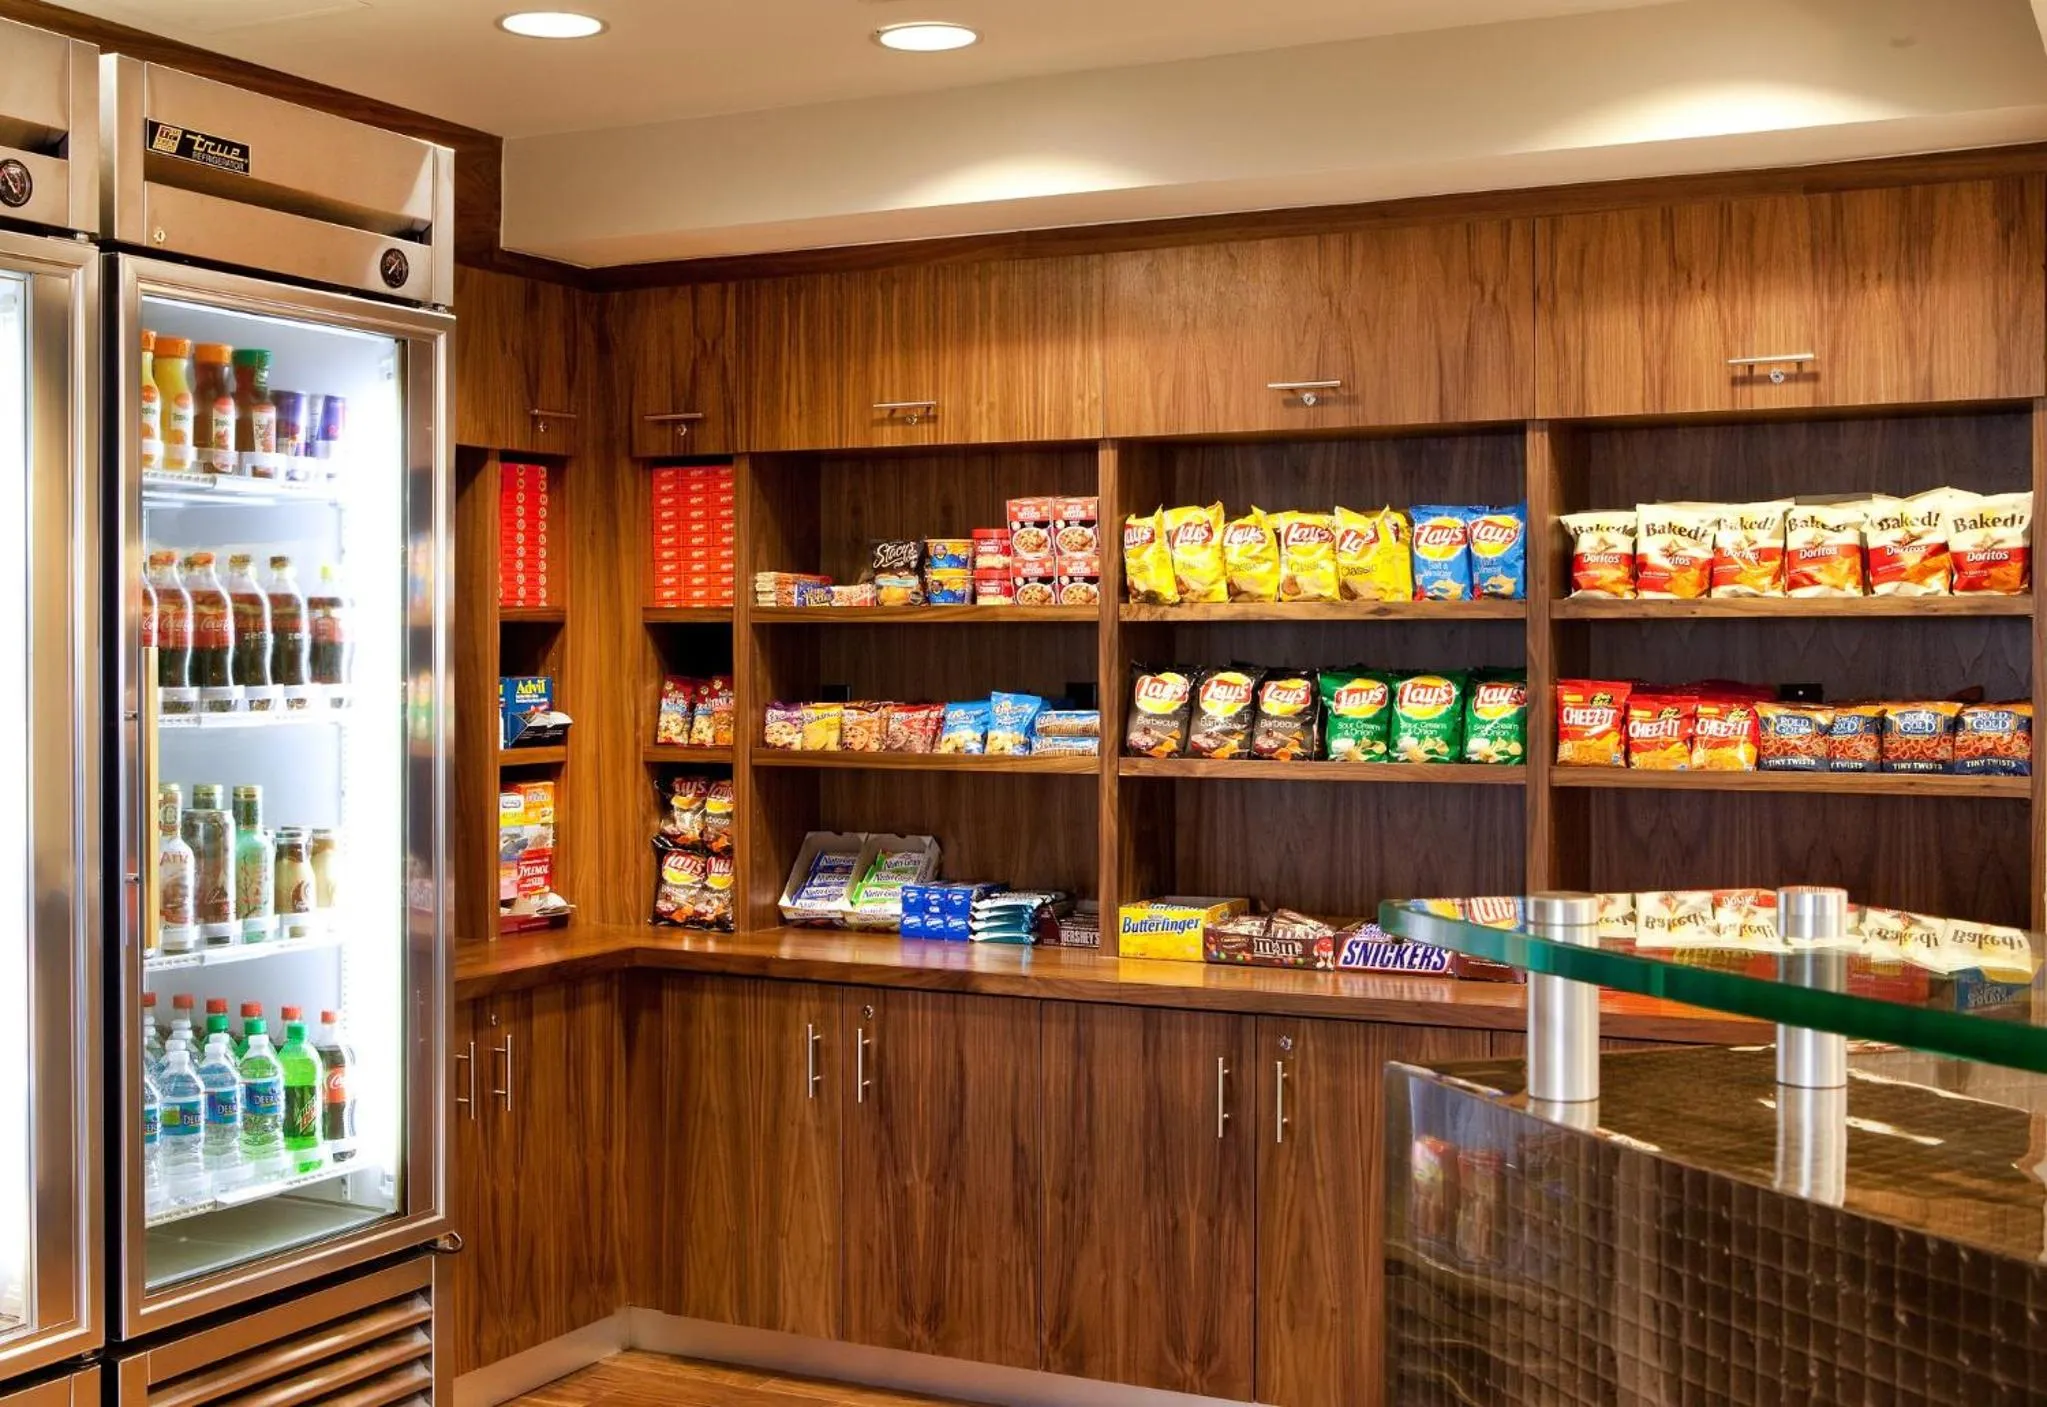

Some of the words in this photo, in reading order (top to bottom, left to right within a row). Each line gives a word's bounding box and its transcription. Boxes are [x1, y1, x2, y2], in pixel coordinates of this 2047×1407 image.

[192, 151, 245, 171] REFRIGERATOR
[1954, 512, 2025, 533] Baked!
[1646, 521, 1709, 542] Baked!
[1584, 553, 1621, 564] Doritos
[1799, 547, 1839, 560] Doritos
[1967, 550, 2010, 563] Doritos
[516, 679, 546, 694] Advil
[1136, 715, 1179, 729] Barbecue
[1563, 706, 1617, 726] CHEEZ-IT
[1260, 719, 1302, 729] Barbecue
[1337, 721, 1353, 730] Sour
[1356, 720, 1381, 731] Cream
[1420, 720, 1447, 730] Cream
[1629, 720, 1681, 738] CHEEZ-IT
[1697, 718, 1752, 738] CHEEZ-IT
[1901, 719, 1936, 732] GOLD
[1972, 718, 2009, 730] GOLD
[1350, 727, 1374, 737] Onion
[1413, 727, 1438, 737] Onion
[1767, 758, 1787, 767] TINY
[1788, 758, 1816, 766] TWISTS
[1833, 761, 1863, 769] TWISTS
[1893, 762, 1911, 770] TINY
[1913, 762, 1943, 770] TWISTS
[1966, 759, 1986, 768] TINY
[1987, 759, 2016, 767] TWISTS
[1123, 917, 1201, 935] Butterfinger
[1342, 940, 1447, 971] SNICKERS
